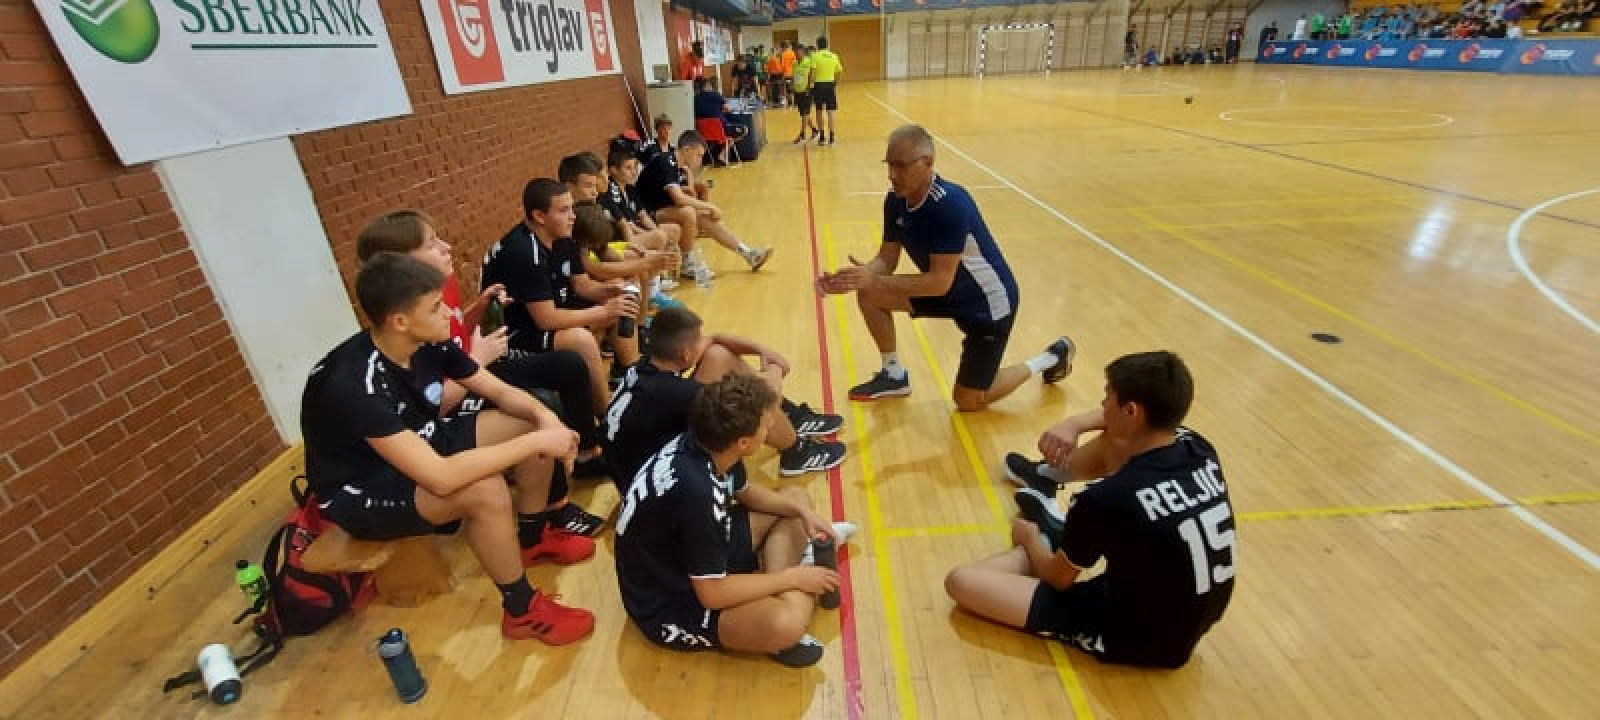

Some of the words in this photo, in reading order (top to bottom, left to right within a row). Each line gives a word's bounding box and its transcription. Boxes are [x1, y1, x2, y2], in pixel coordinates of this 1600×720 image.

[172, 0, 374, 37] SBERBANK
[500, 0, 584, 74] triglav
[1178, 502, 1237, 595] 15
